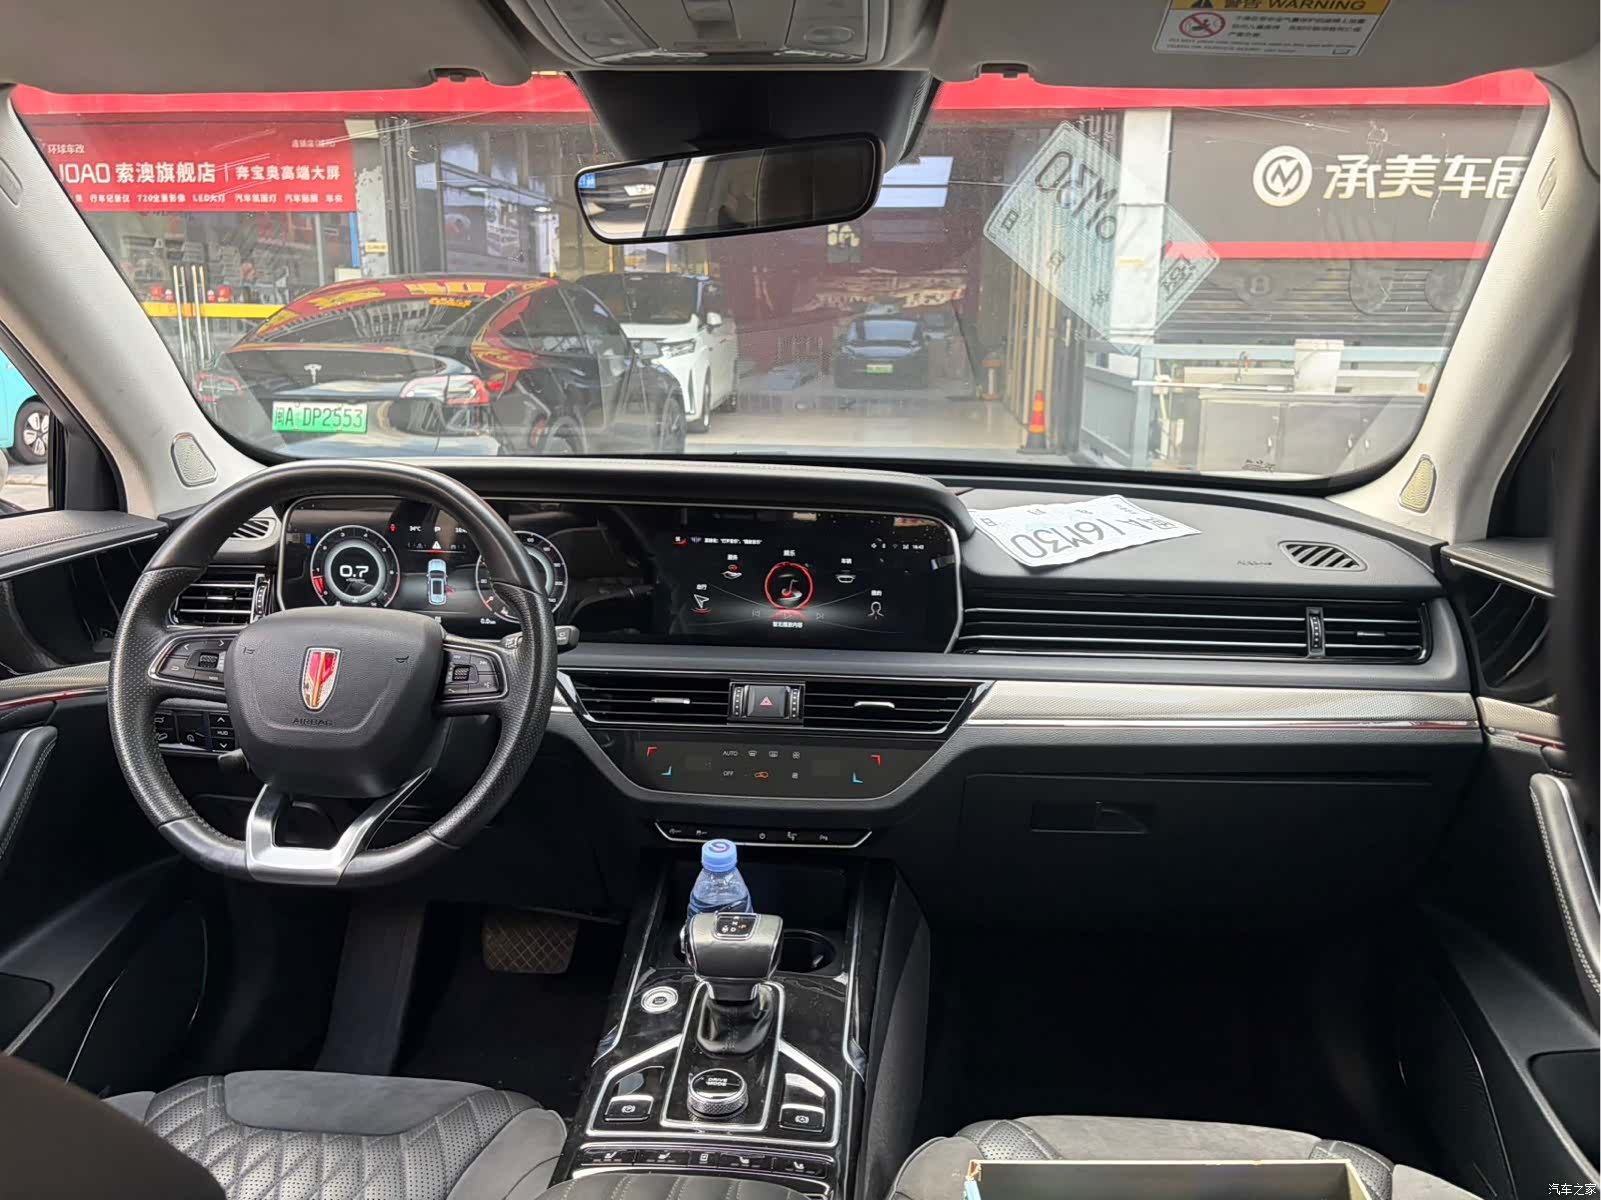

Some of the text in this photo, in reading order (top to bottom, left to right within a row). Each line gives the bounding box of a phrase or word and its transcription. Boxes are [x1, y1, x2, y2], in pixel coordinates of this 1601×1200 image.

[1268, 0, 1367, 10] WARNING
[115, 161, 216, 184] 索澳旗舰店
[303, 407, 364, 428] DP2553
[339, 565, 370, 578] 0.7
